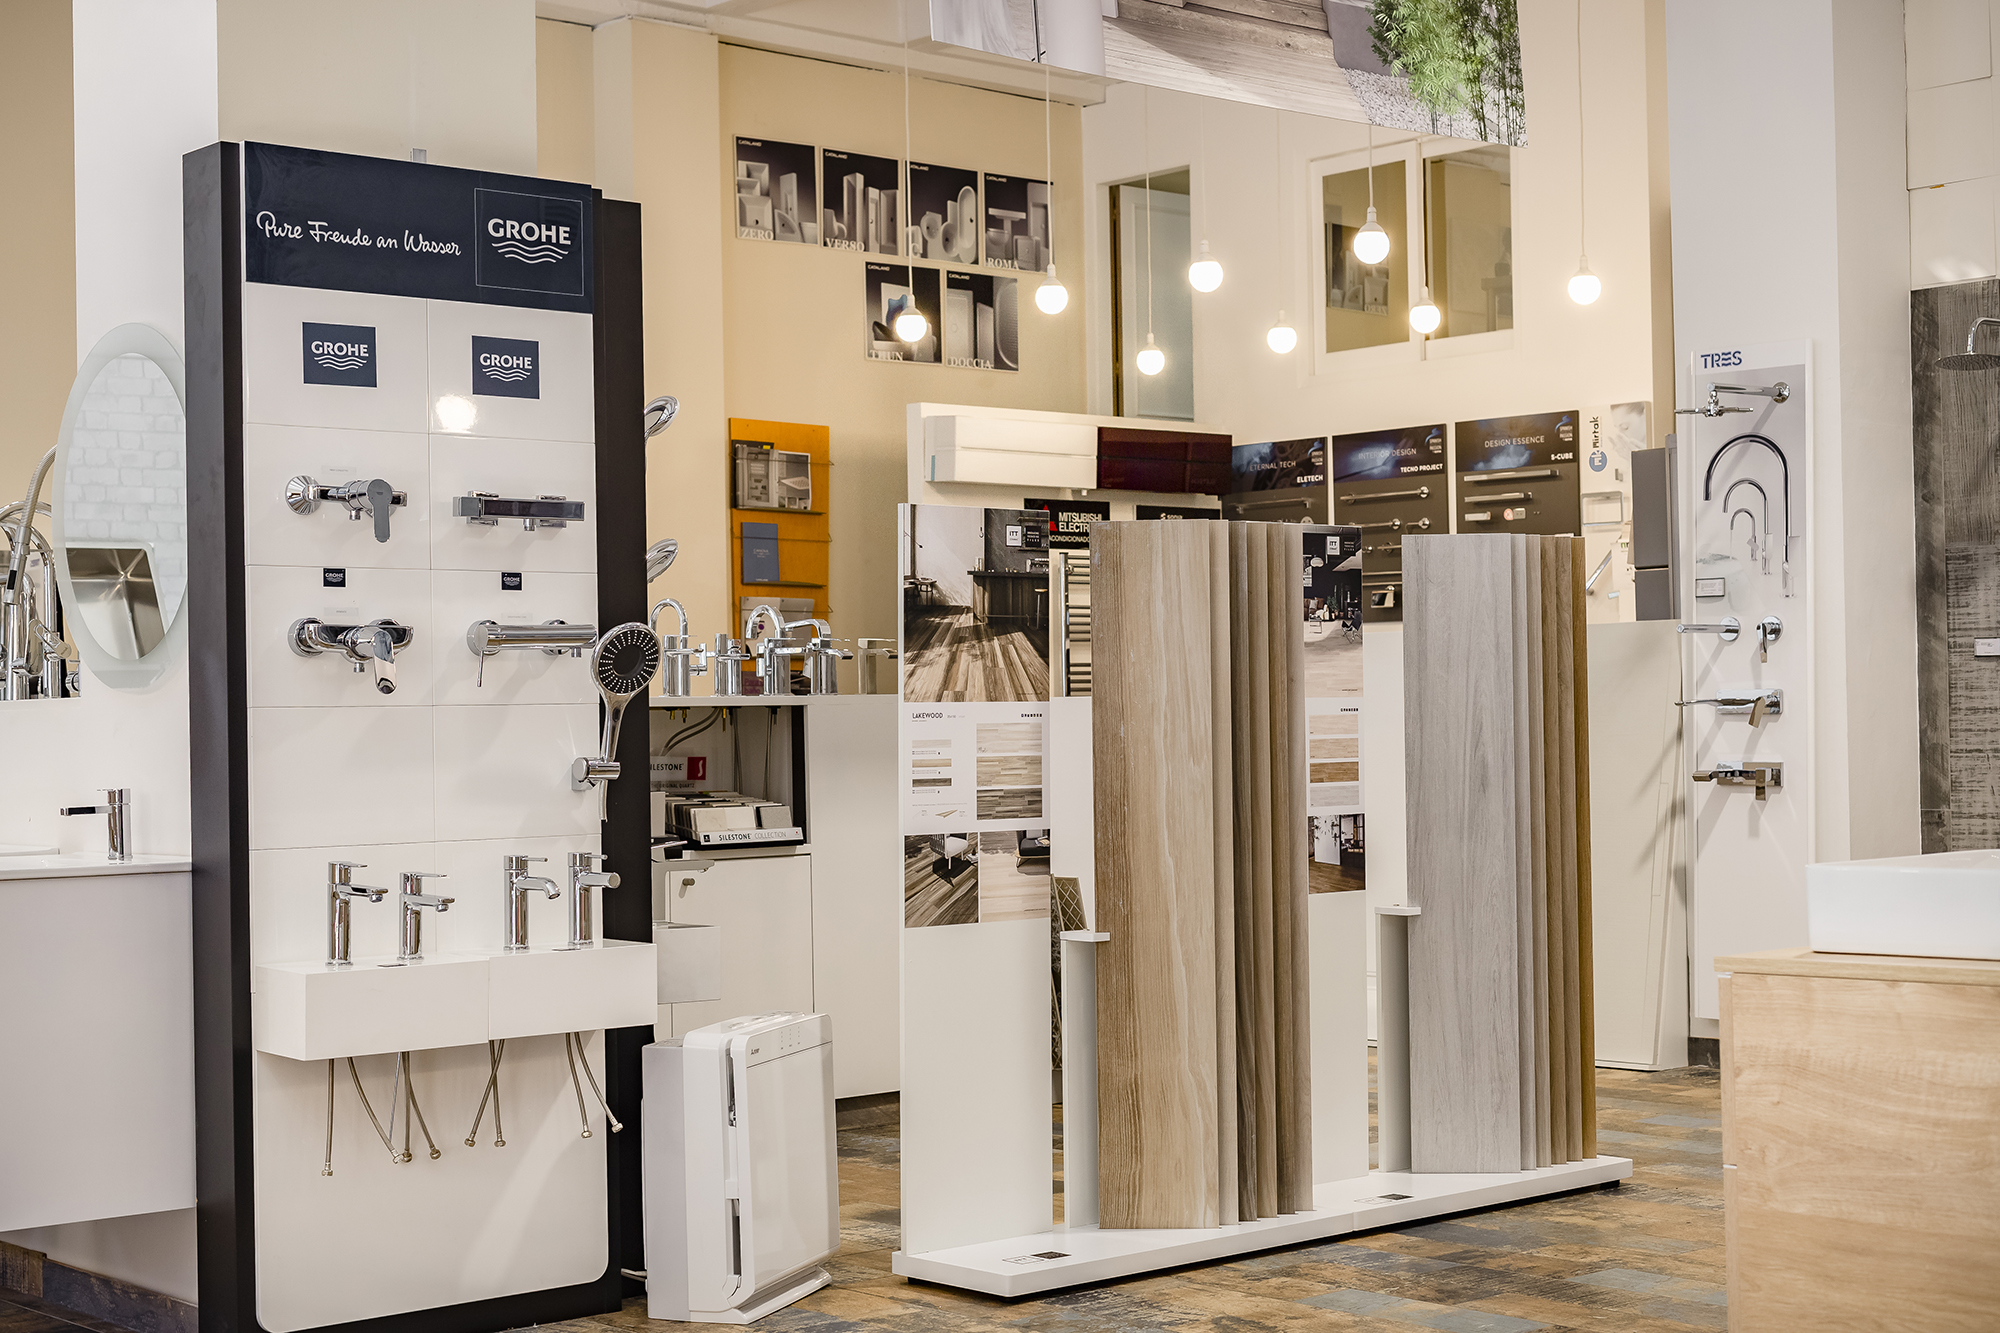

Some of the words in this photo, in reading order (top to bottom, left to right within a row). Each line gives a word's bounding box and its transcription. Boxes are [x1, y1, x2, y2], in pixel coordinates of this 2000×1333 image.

[738, 139, 763, 147] CATALANO
[825, 151, 848, 160] CATALANO
[986, 175, 1008, 183] CATALANO
[256, 210, 304, 240] Pure
[308, 220, 372, 248] Freude
[376, 235, 399, 249] an
[403, 229, 462, 257] Wasser
[487, 217, 572, 246] GROHE
[740, 227, 775, 240] ZERO
[825, 237, 865, 252] VERSO
[867, 264, 891, 272] CATALANO
[987, 257, 1020, 270] ROMA
[948, 273, 970, 281] CATALANO
[310, 339, 370, 358] GROHE
[869, 349, 904, 361] THUN
[1700, 350, 1743, 369] TRES
[479, 352, 533, 371] GROHE
[949, 356, 993, 370] DOCCIA
[1589, 416, 1600, 449] Mirtak
[1484, 438, 1511, 448] DESIGN
[1512, 435, 1545, 445] ESSENCE
[1358, 450, 1390, 460] INTERIOR
[1391, 448, 1417, 457] DESIGN
[1551, 452, 1574, 461] S-CUBE
[1250, 463, 1278, 472] ETERNAL
[1280, 460, 1297, 468] TECH
[1400, 465, 1419, 473] TECNO
[1419, 463, 1444, 472] PROJECT
[1296, 474, 1324, 484] ELETECH
[1058, 511, 1103, 522] MITSUBISHI
[1058, 522, 1090, 533] ELECTR
[912, 712, 944, 720] LAKEWOOD
[650, 763, 682, 771] ILESTONE
[718, 832, 751, 842] SILESTONE
[754, 831, 787, 840] COLLECTION
